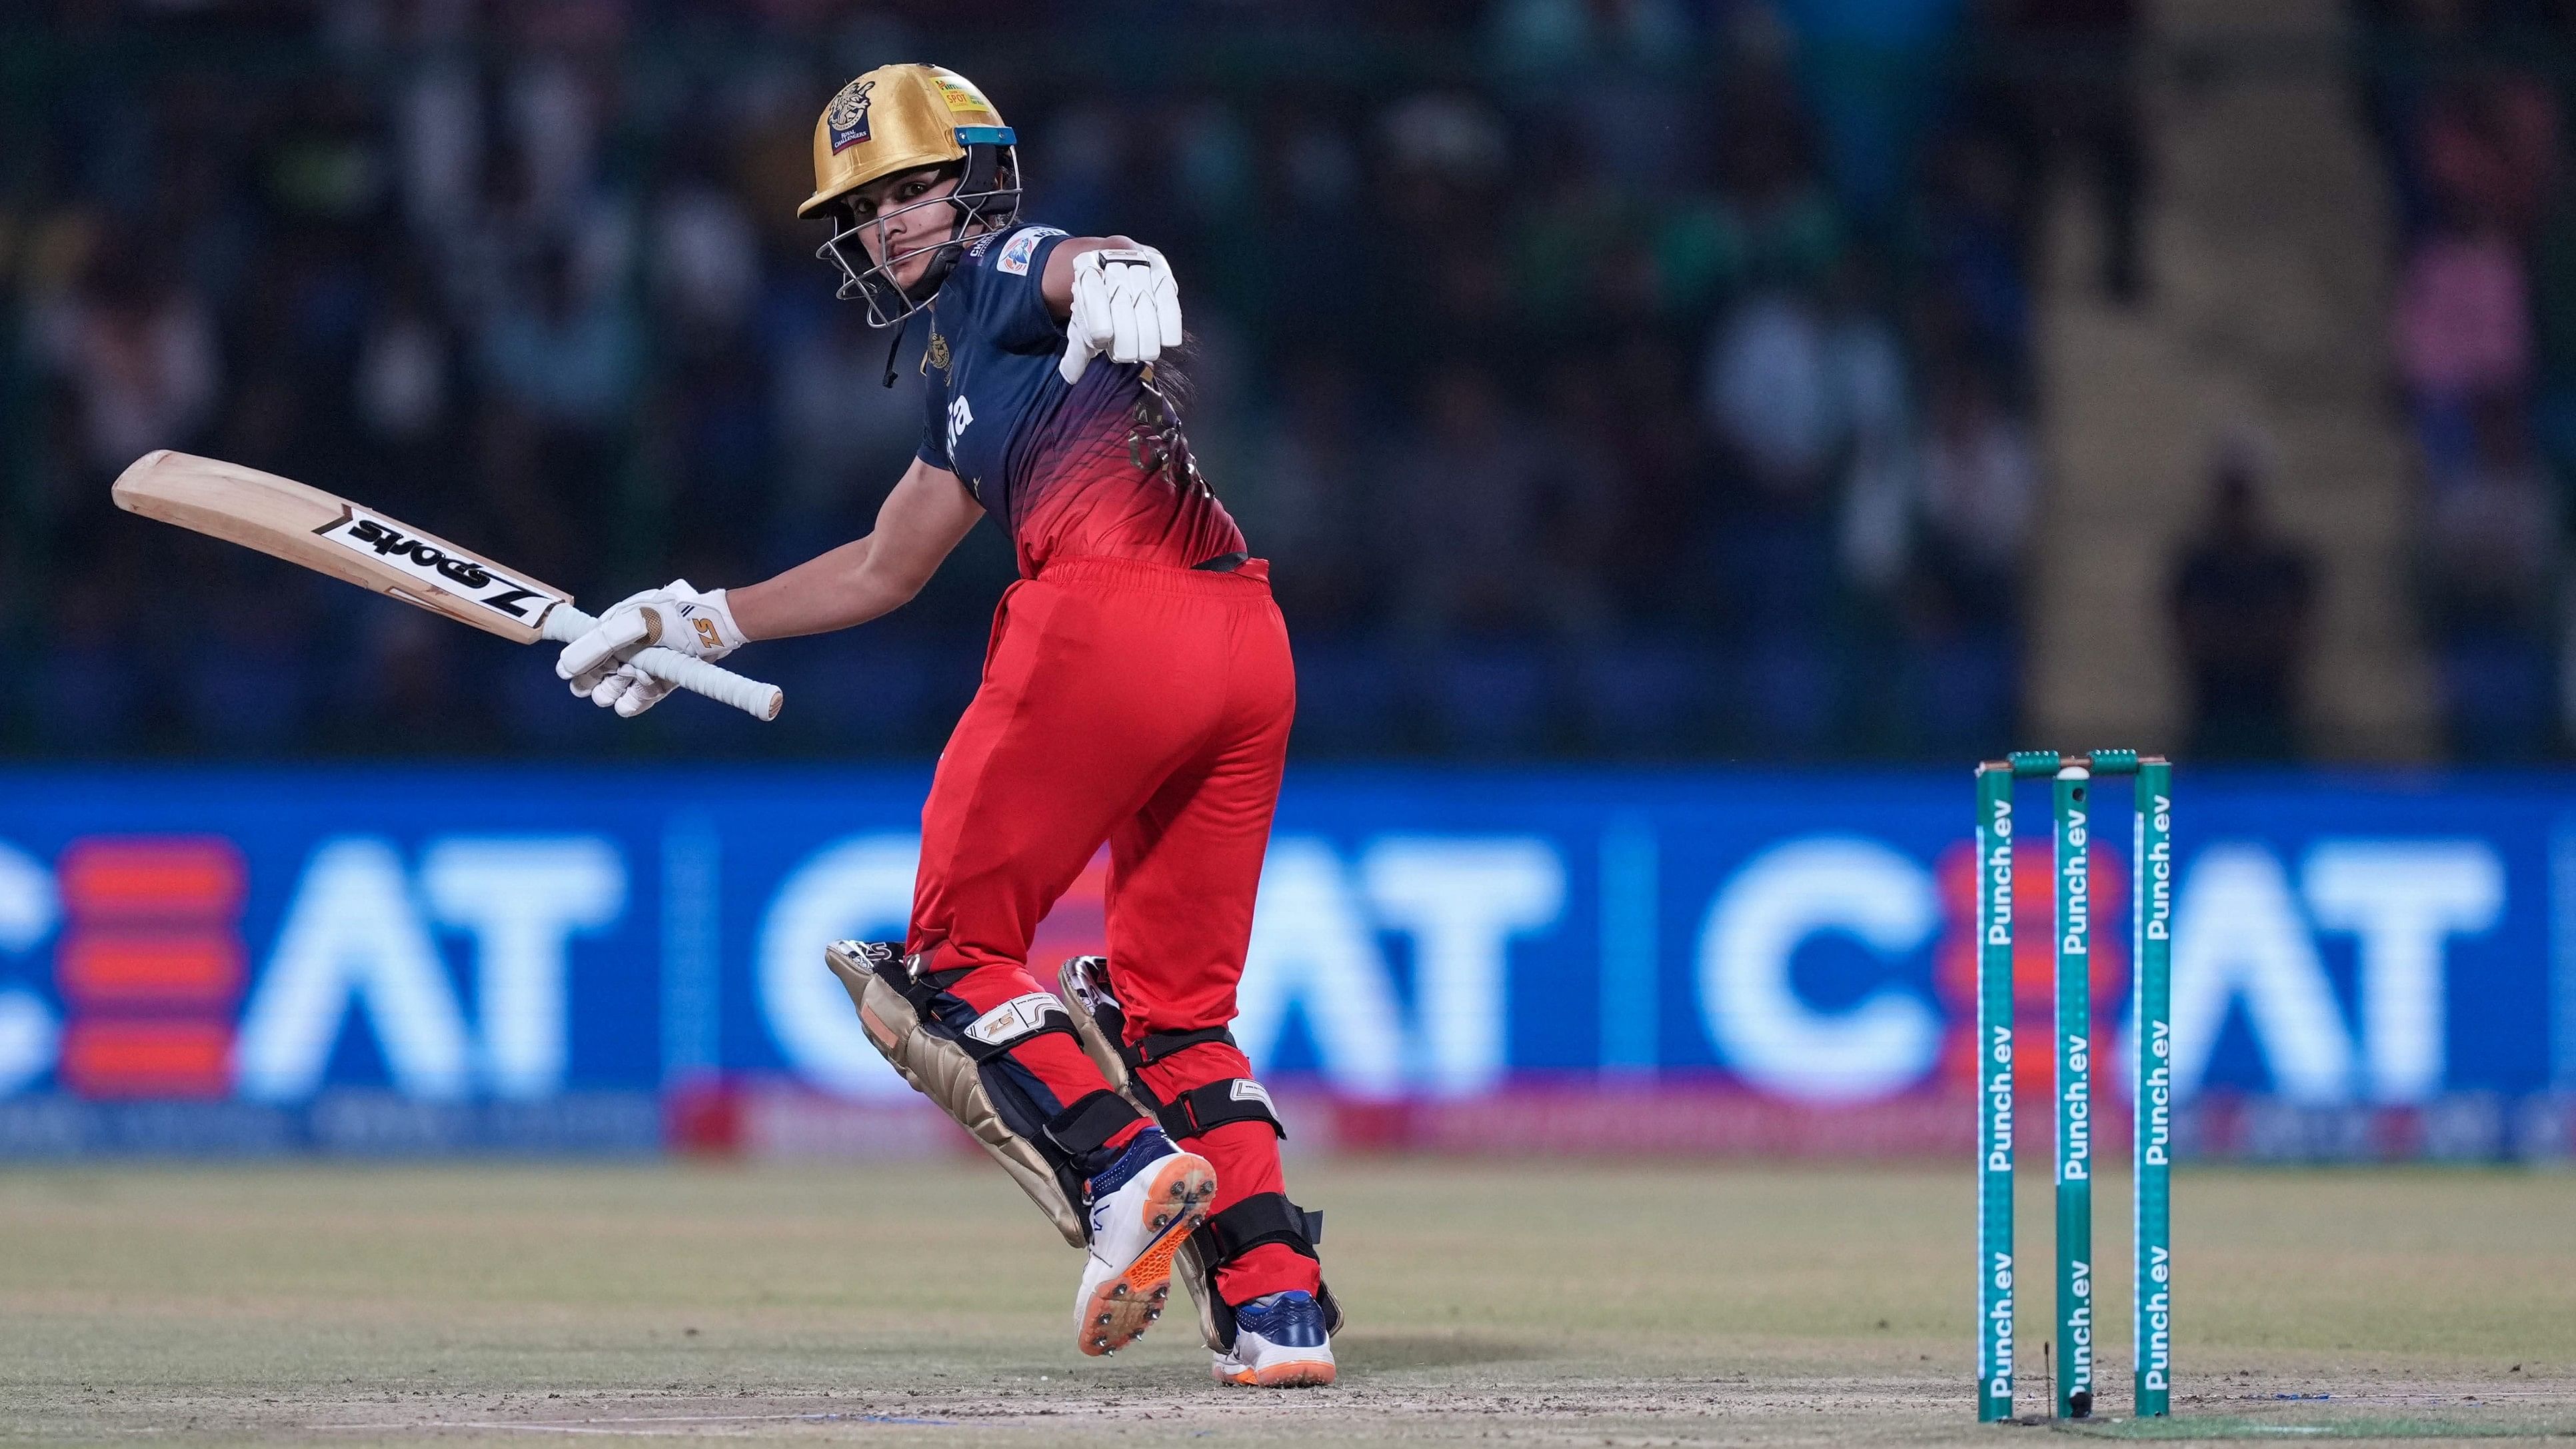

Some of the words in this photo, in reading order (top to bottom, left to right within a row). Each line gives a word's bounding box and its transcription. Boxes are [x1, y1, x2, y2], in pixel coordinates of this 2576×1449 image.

[946, 94, 967, 103] SPOT
[1988, 799, 2011, 945] Punch.ev
[2063, 808, 2086, 954] Punch.ev
[2147, 794, 2170, 940] Punch.ev
[0, 837, 625, 1098] EAT
[984, 1012, 1014, 1038] ZS
[1988, 1025, 2011, 1172] Punch.ev
[2064, 1034, 2088, 1180] Punch.ev
[2145, 1020, 2168, 1166] Punch.ev
[1989, 1252, 2012, 1398] Punch.ev
[2145, 1245, 2168, 1390] Punch.ev
